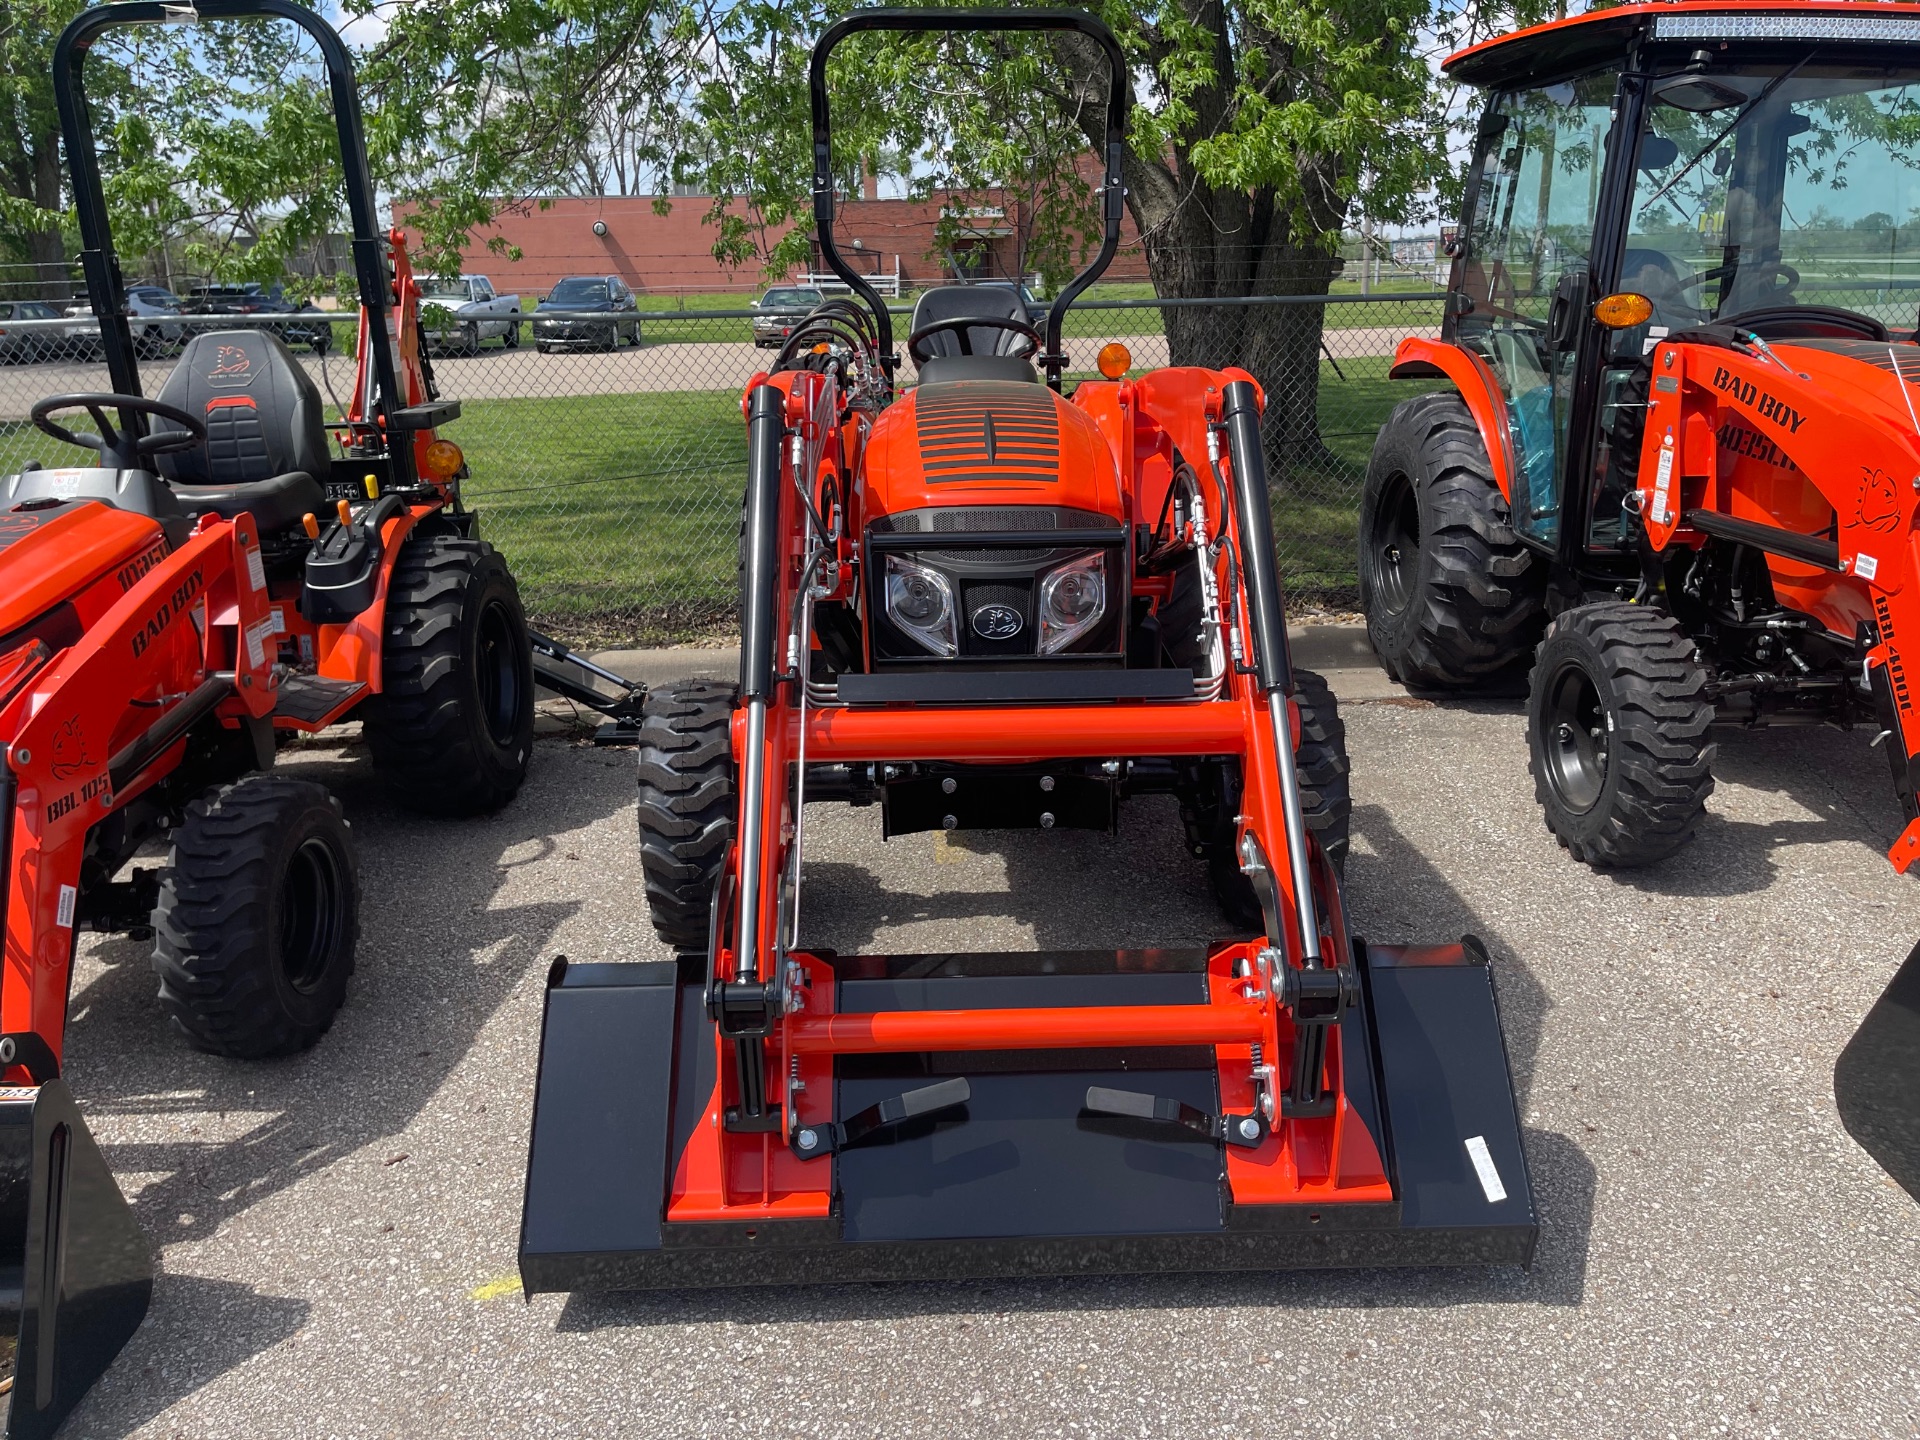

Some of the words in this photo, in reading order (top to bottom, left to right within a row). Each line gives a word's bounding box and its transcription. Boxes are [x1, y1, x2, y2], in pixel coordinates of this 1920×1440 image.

[1713, 366, 1758, 407] BAD
[1757, 392, 1808, 435] BOY
[131, 603, 171, 659] BAD
[171, 561, 204, 614] BOY
[1875, 595, 1895, 648] BBL
[47, 791, 80, 824] BBL
[81, 771, 109, 803] 105
